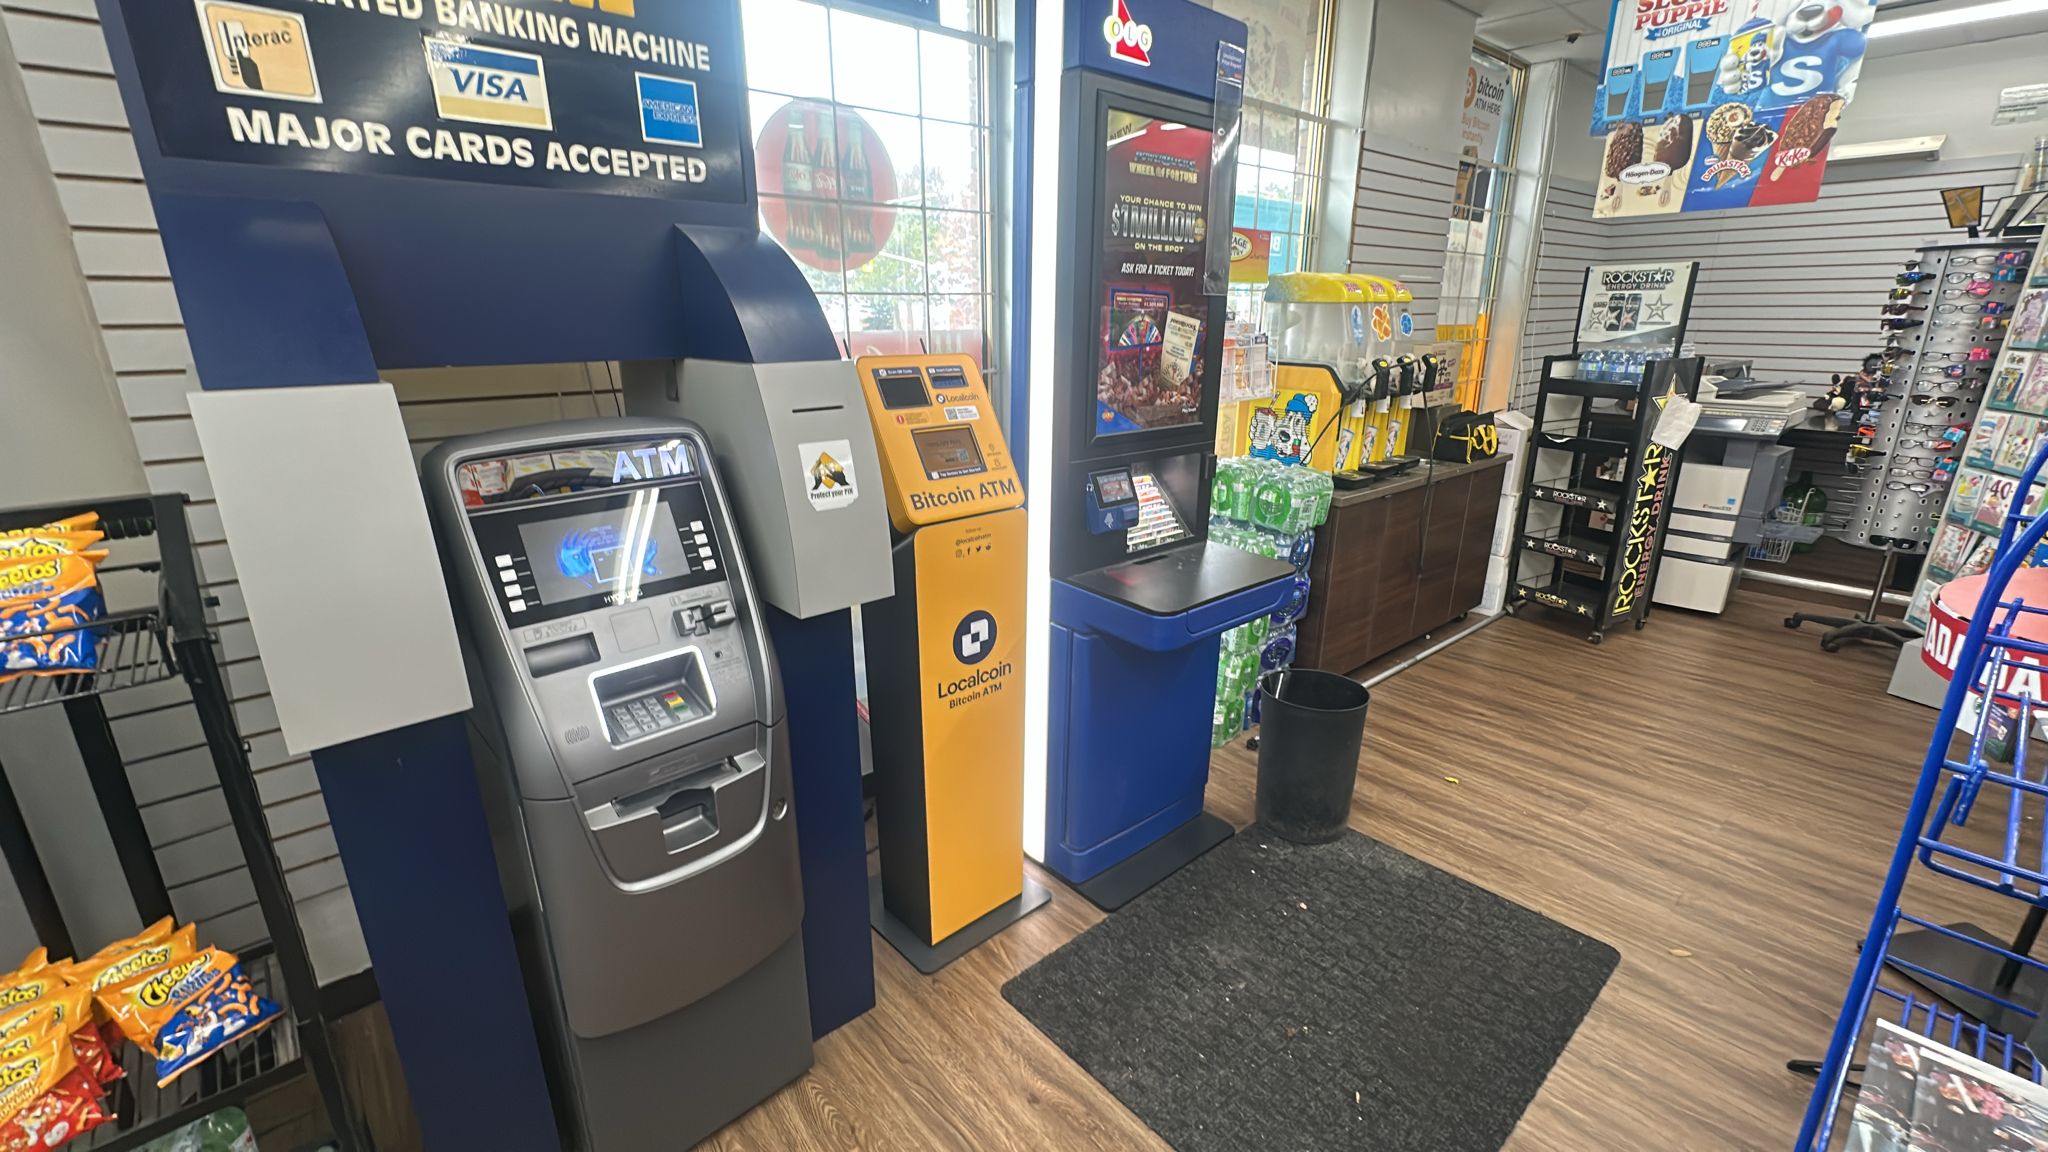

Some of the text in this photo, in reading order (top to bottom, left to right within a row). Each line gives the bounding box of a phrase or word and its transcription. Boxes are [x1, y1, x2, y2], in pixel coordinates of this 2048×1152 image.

[436, 0, 580, 48] BANKING
[588, 22, 711, 72] MACHINE
[1111, 20, 1149, 46] OLG
[1662, 19, 1702, 37] ORIGINAL
[449, 67, 529, 103] VISA
[1477, 74, 1505, 102] bitcoin
[1771, 55, 1824, 96] S
[642, 98, 694, 116] AMERICAN
[1474, 97, 1501, 116] ATM HERE
[226, 106, 707, 183] MAJOR CARDS ACCEPTED
[1129, 161, 1155, 176] WHEEL
[1165, 167, 1198, 184] FORTUNE
[1701, 159, 1751, 182] DRUMSTICK
[1120, 194, 1202, 212] YOUR CHANCE TO WIN
[1134, 242, 1184, 253] ON THE SPOT
[1121, 262, 1195, 277] ASK FOR A TICKET TODAY!
[612, 444, 690, 484] ATM
[810, 487, 854, 500] Protect your PIN
[910, 478, 1016, 511] Bitcoin ATM
[1651, 456, 1673, 516] DRINK
[937, 661, 1012, 699] Localcoin
[949, 682, 1002, 709] Bitcoin ATM
